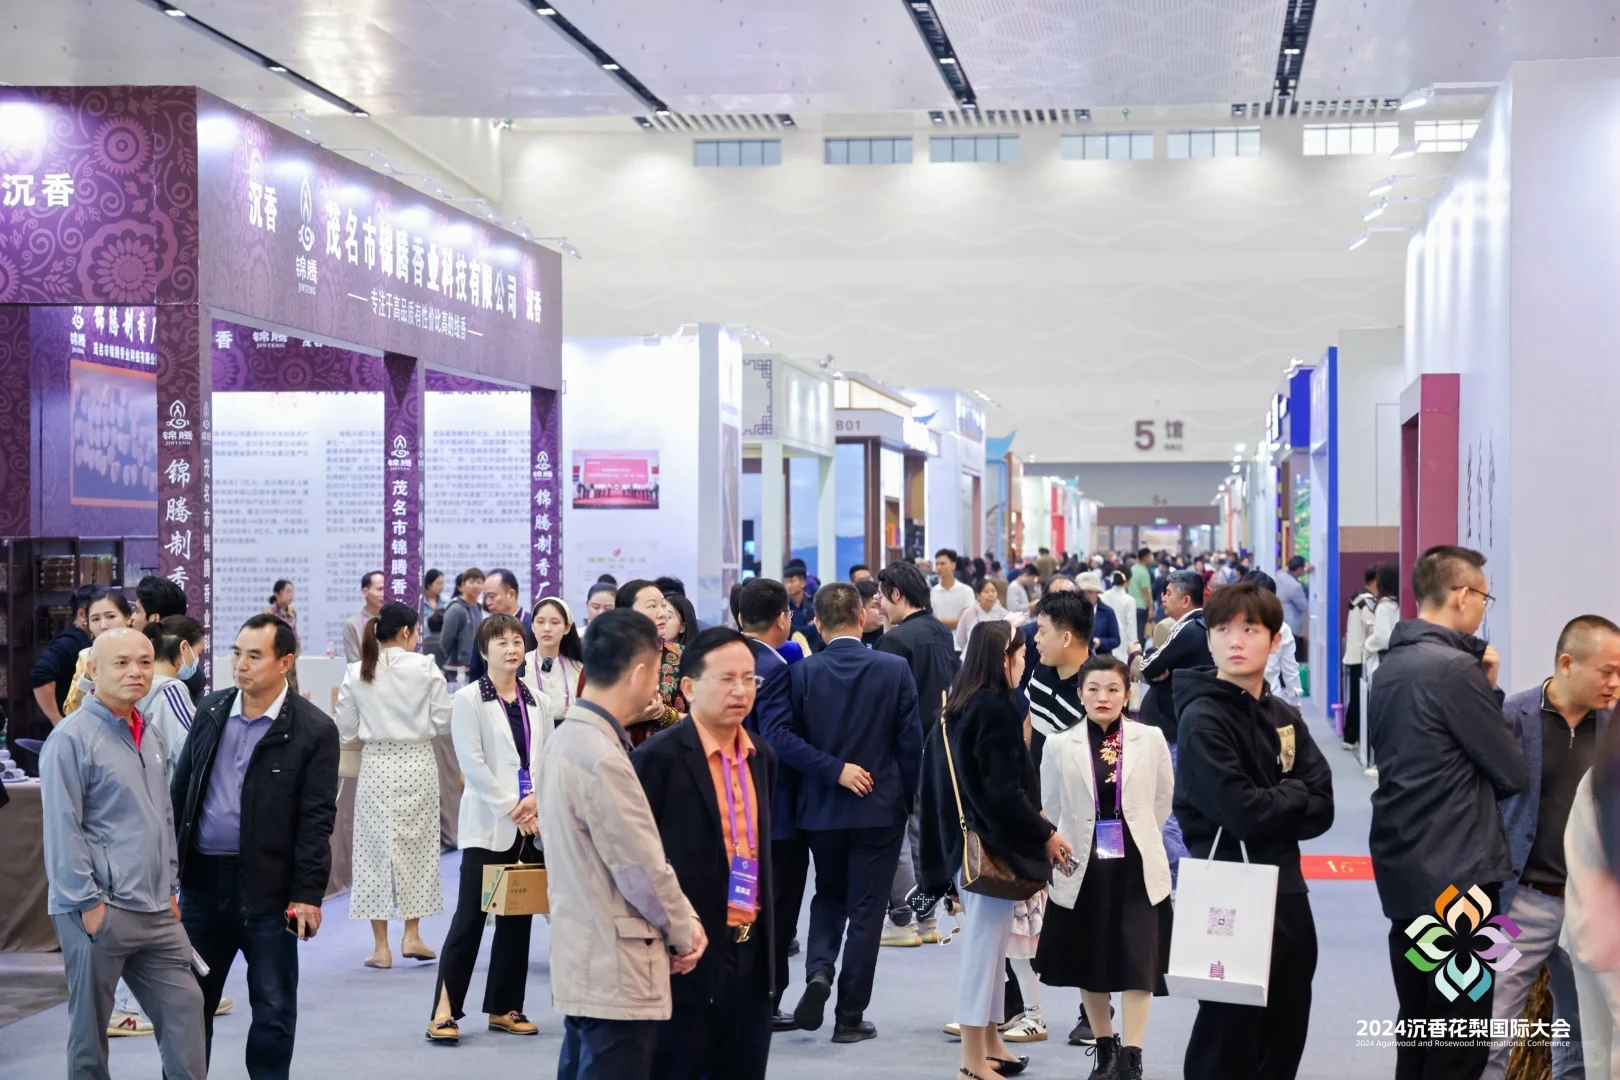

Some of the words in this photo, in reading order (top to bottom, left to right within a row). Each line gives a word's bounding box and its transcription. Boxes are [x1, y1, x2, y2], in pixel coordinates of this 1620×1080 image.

[1, 173, 74, 207] 沉香
[248, 180, 278, 233] 沉香
[295, 254, 318, 284] 锦腾
[325, 200, 517, 320] 茂名市锦腾香业科技有限公司
[297, 282, 317, 296] JINTENG
[525, 285, 542, 325] 沉香
[370, 287, 467, 341] 专注于高品质有性价比高的线香
[92, 342, 157, 365] 茂名市锦腾香业科技有限公
[215, 330, 233, 349] 香
[162, 430, 194, 441] 锦腾
[1134, 419, 1156, 451] 5
[387, 458, 412, 468] 锦腾
[164, 458, 192, 608] 锦腾制香
[390, 479, 408, 605] 茂名市锦腾香
[533, 488, 552, 600] 锦腾制香厂
